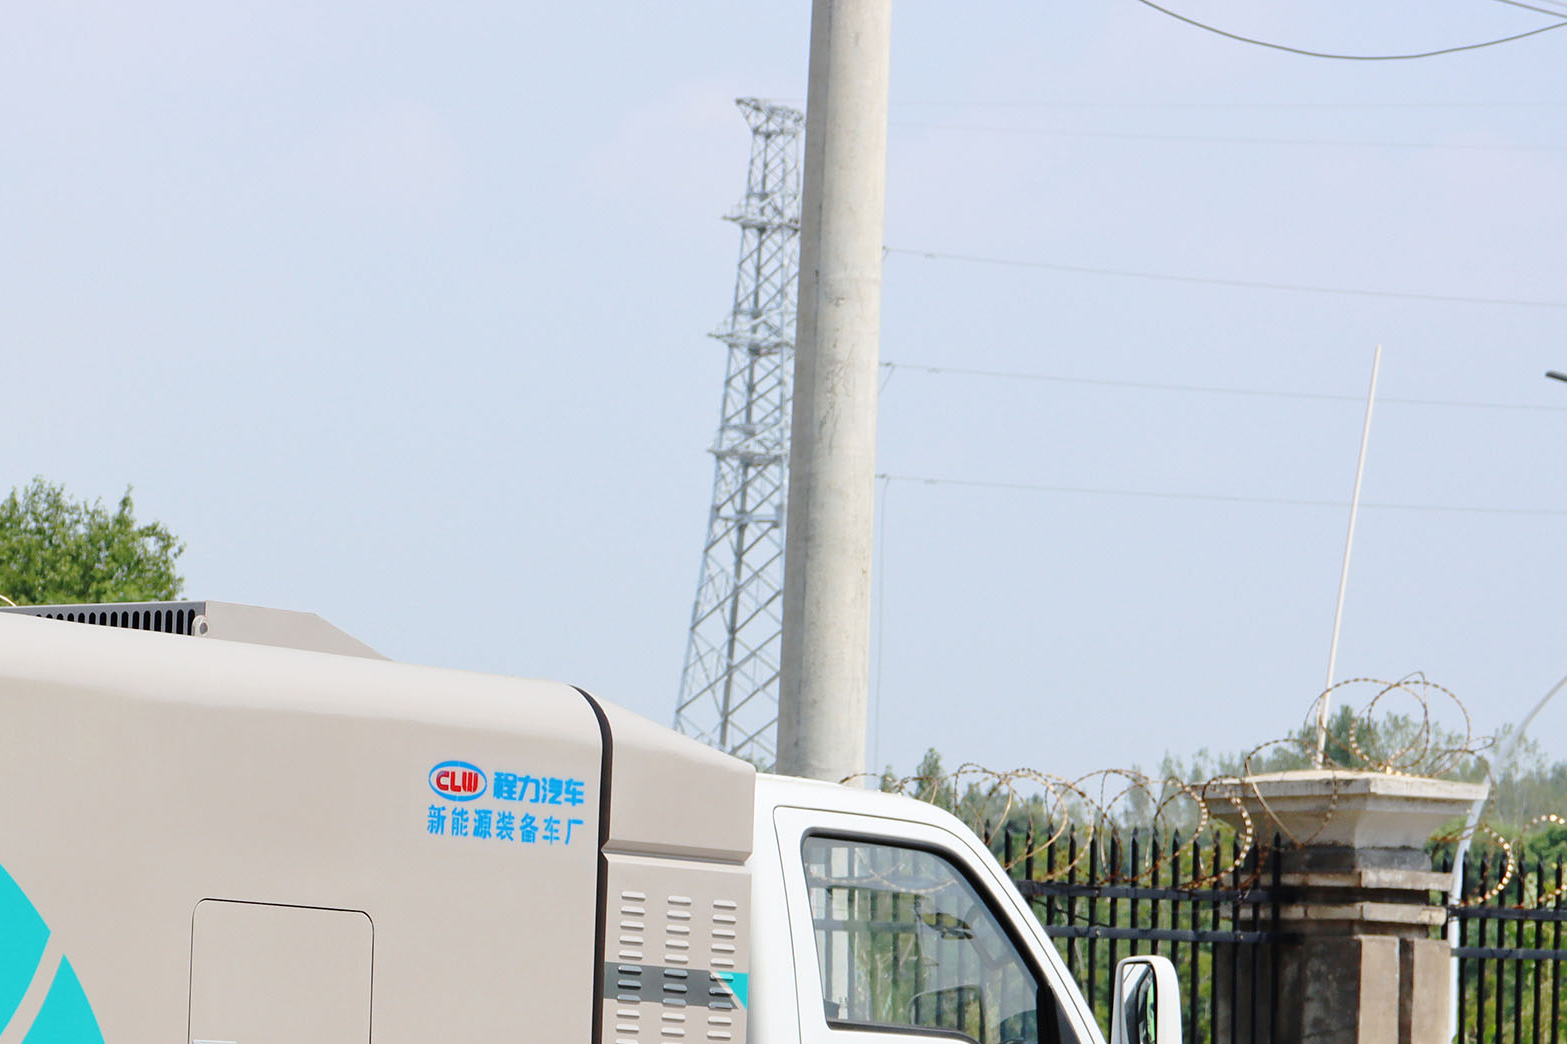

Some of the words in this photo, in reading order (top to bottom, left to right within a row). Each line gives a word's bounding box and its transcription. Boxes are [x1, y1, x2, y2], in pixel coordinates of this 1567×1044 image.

[435, 770, 478, 792] CLW
[493, 771, 585, 806] 程力汽车
[427, 804, 584, 845] 新能源装备车厂
